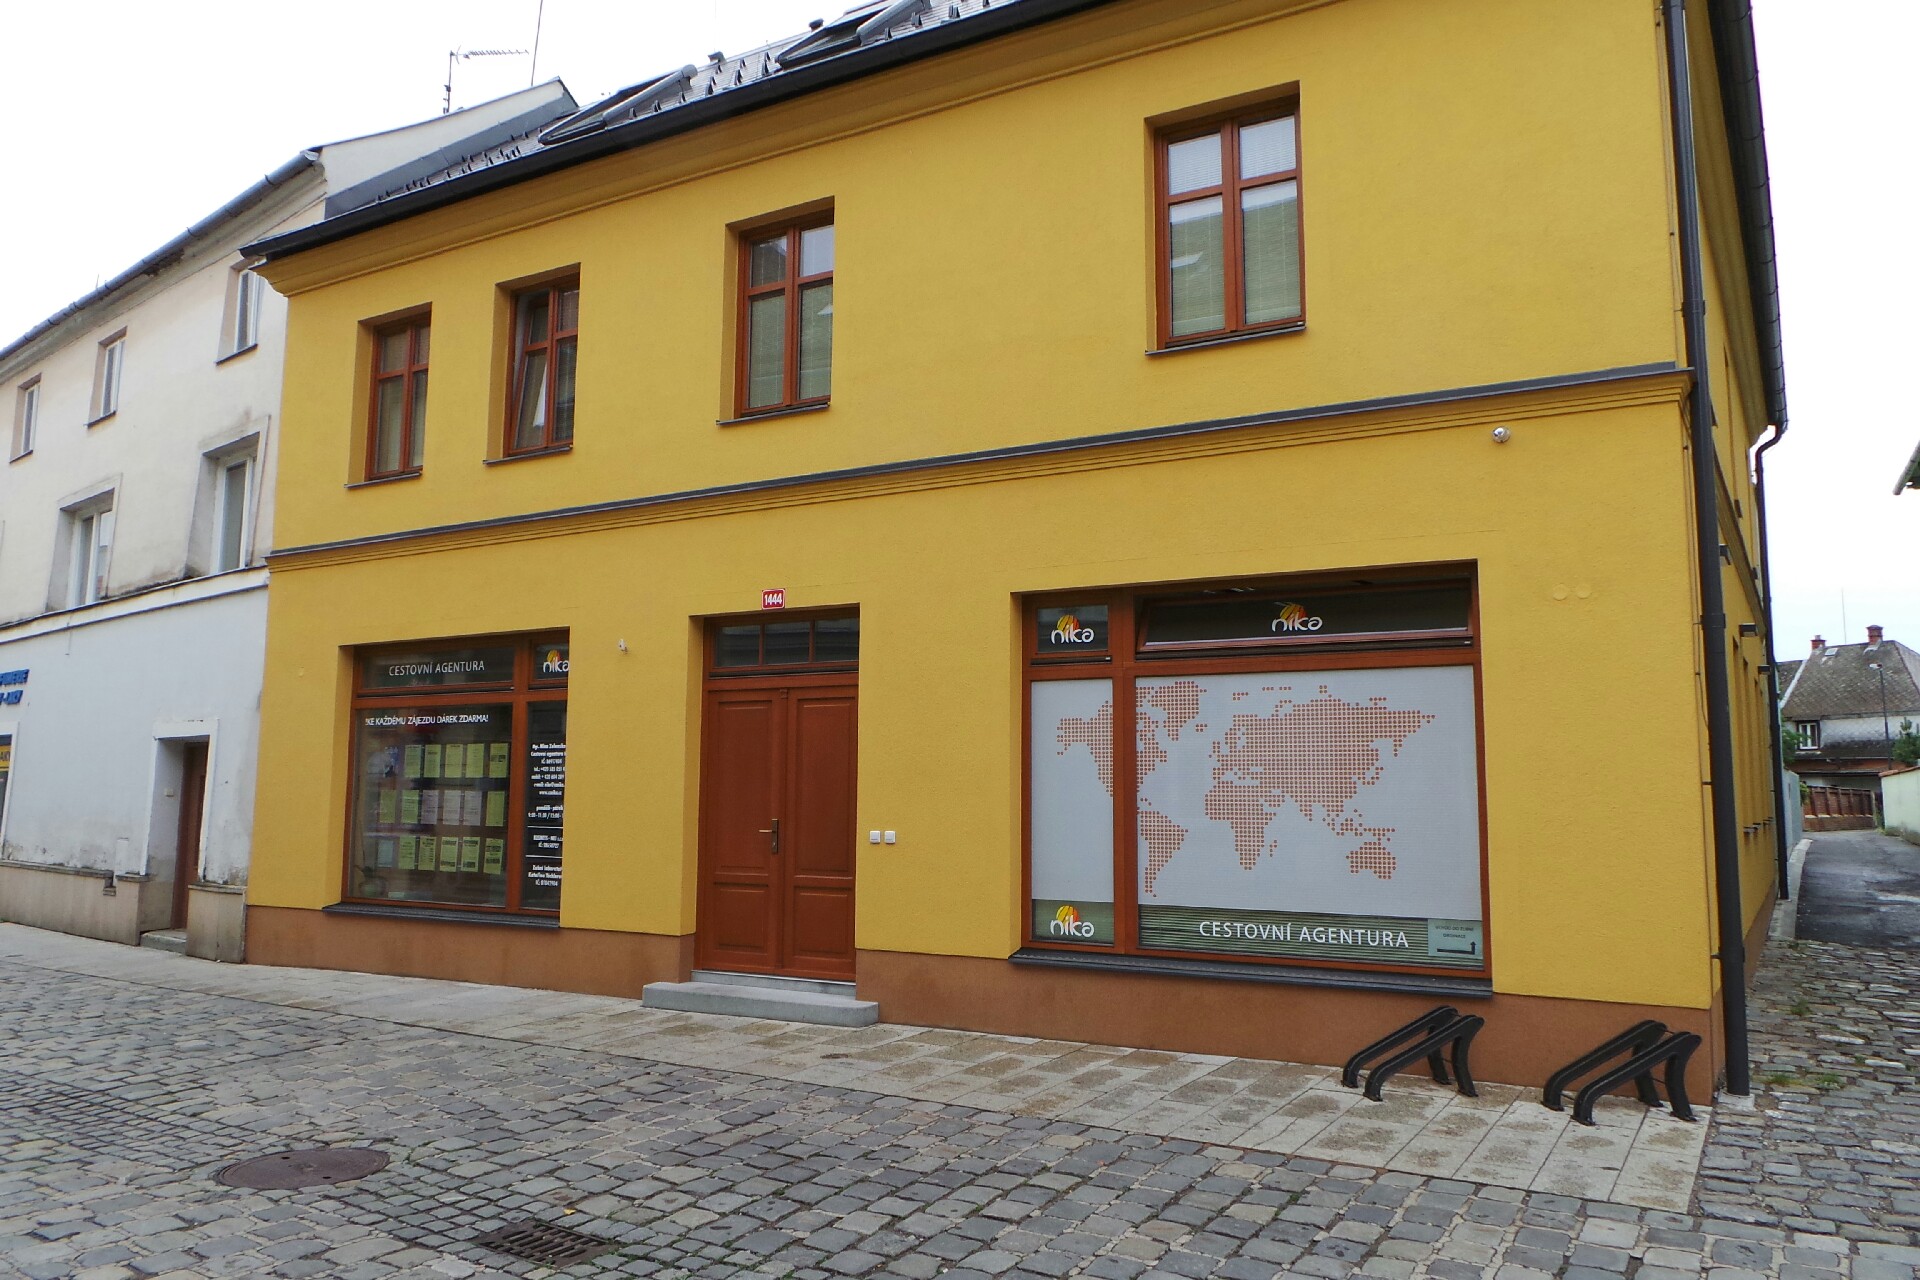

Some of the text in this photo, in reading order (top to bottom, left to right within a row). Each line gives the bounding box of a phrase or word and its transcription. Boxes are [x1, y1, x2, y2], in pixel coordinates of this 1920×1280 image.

[764, 592, 783, 606] 1444
[1271, 614, 1323, 632] nika
[1050, 624, 1095, 644] nika
[389, 660, 485, 676] CESTOVNÍ AGENTURA
[542, 658, 569, 673] nika
[375, 715, 406, 726] KAŽDÉMU
[407, 713, 436, 727] ZÁJEZDU
[436, 713, 458, 724] DÁREK
[458, 714, 489, 723] ZDARMA!
[1050, 914, 1095, 938] nika
[1199, 921, 1409, 948] CESTOVNÍ AGENTURA
